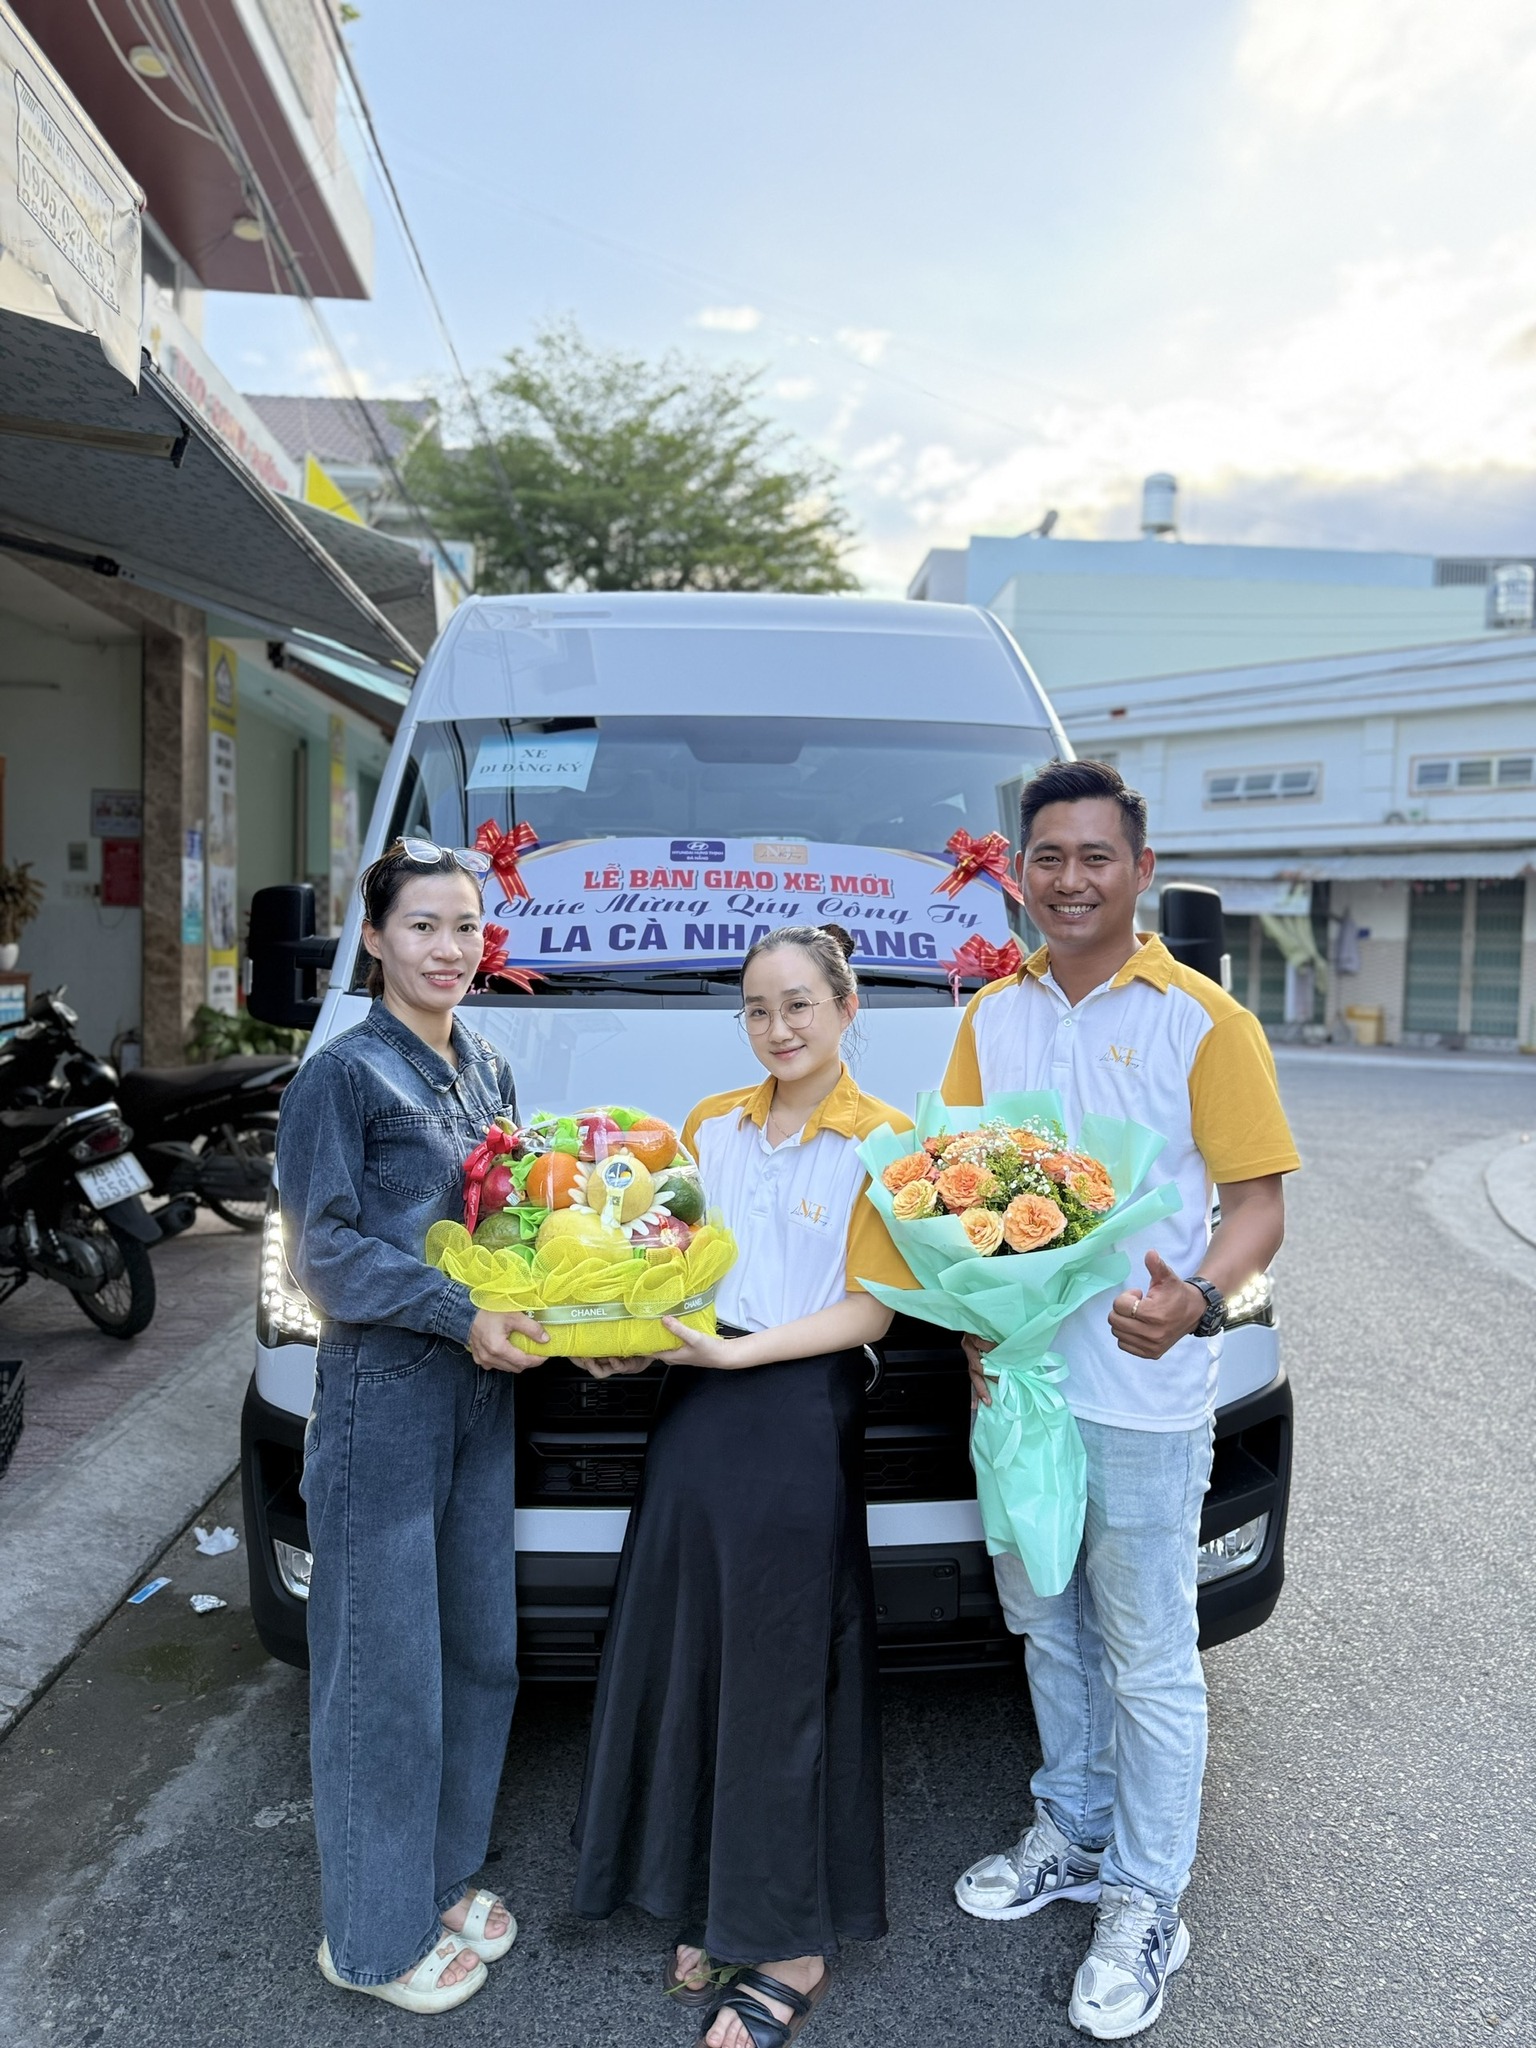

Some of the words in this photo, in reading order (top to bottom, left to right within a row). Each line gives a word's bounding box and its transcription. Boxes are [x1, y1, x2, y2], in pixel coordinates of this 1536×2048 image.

[522, 749, 548, 759] XE
[557, 761, 583, 773] KÝ
[584, 863, 622, 890] LỄ
[630, 866, 695, 889] BÀN
[704, 870, 774, 890] GIAO
[784, 872, 822, 892] XE
[830, 874, 890, 895] MỚI
[494, 898, 585, 918] Chúc
[595, 893, 712, 917] Mừng
[817, 897, 912, 925] Công
[927, 904, 982, 928] Ty
[540, 925, 592, 953] LA
[609, 918, 668, 950] CÀ
[97, 1175, 141, 1202] 6591
[571, 1308, 607, 1317] CHANEL
